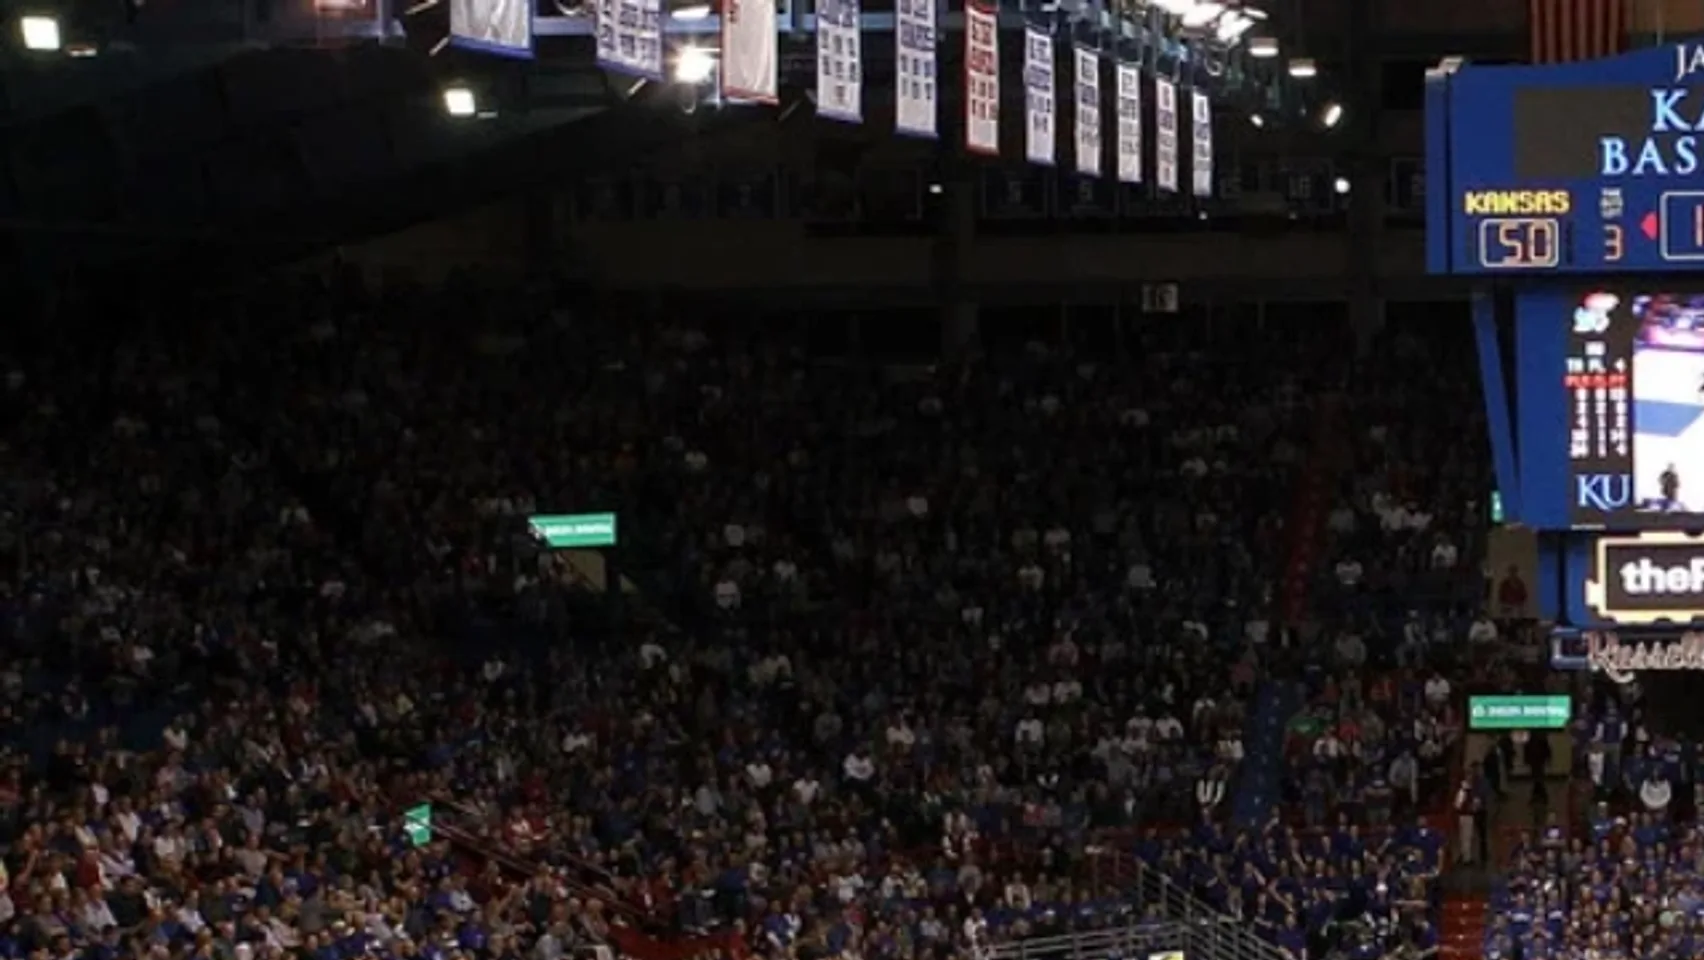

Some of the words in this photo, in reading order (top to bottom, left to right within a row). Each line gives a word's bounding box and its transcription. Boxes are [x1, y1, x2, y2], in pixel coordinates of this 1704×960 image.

[1464, 190, 1571, 215] KANSAS
[1498, 220, 1552, 266] 50
[1603, 224, 1623, 260] 3
[1577, 474, 1630, 511] KU
